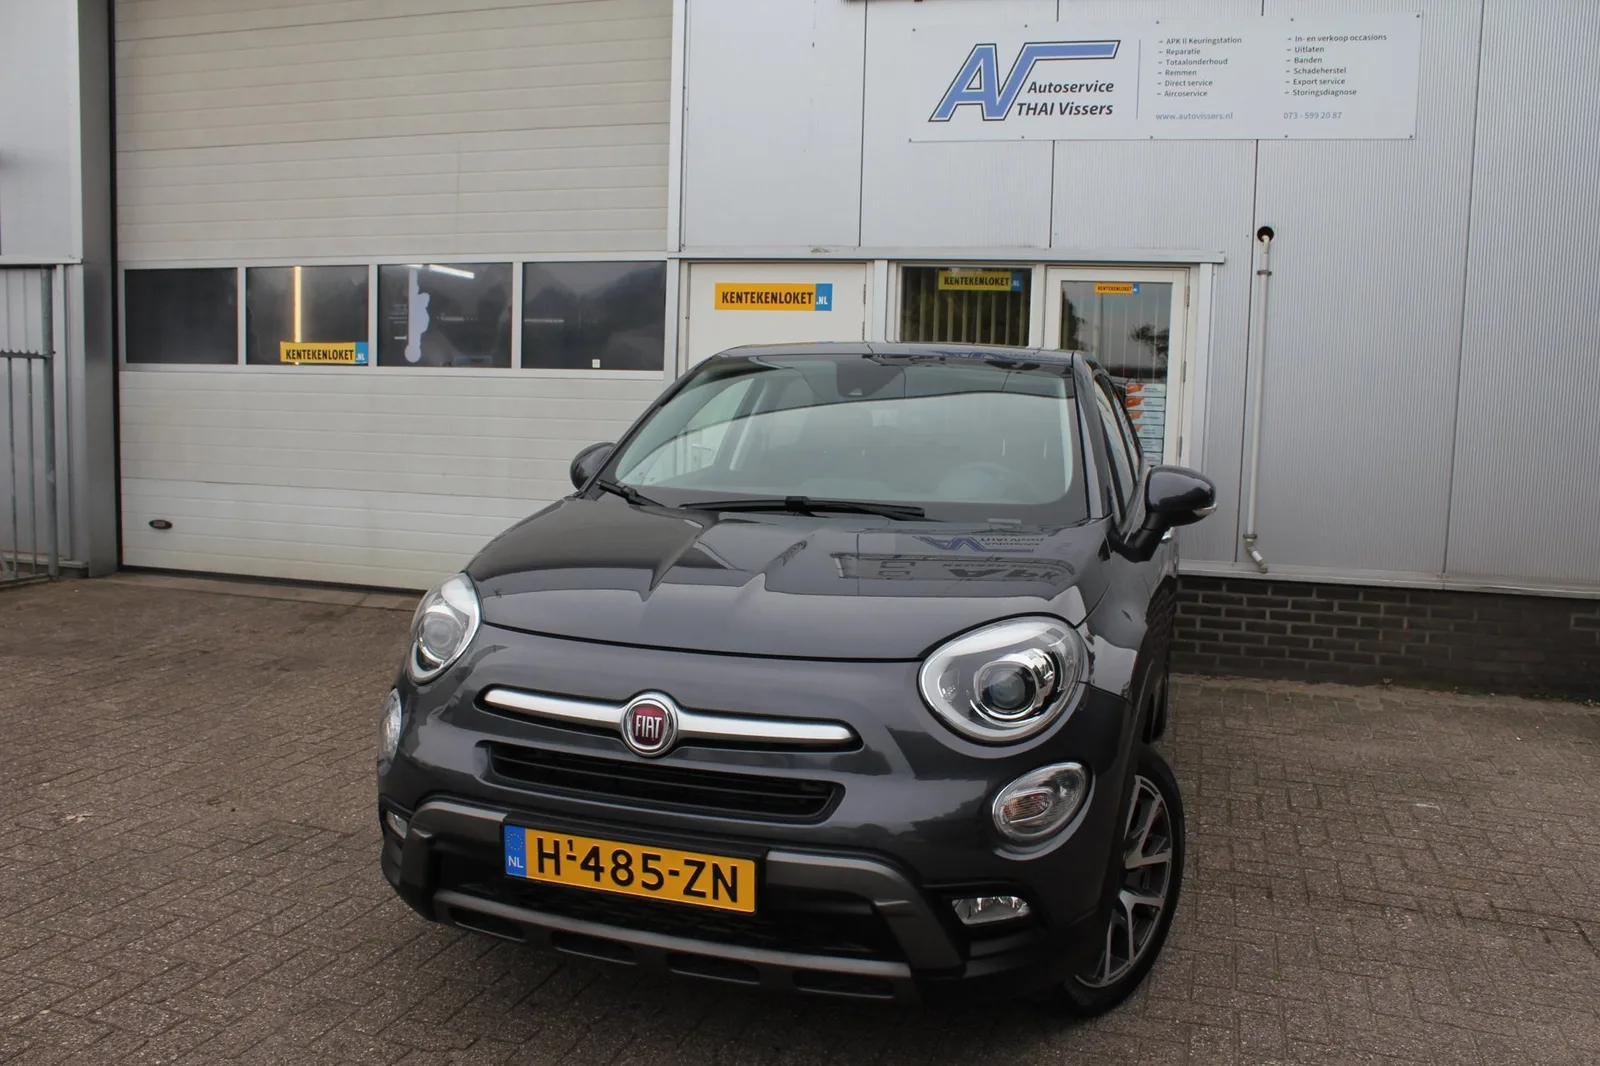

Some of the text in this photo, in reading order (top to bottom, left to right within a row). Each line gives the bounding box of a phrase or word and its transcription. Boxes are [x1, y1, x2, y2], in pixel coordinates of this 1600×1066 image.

[1188, 37, 1242, 45] Keuringstation
[1317, 35, 1348, 43] verkoop
[1166, 48, 1201, 56] Reparatie
[1166, 58, 1228, 66] Totaalonderhoud
[1293, 78, 1318, 86] Export
[1027, 80, 1114, 94] Autoservice
[1292, 89, 1357, 97] Storingsdiagnose
[1016, 101, 1114, 117] THAI Vissers
[1155, 112, 1234, 120] www.autovissers.nl
[635, 714, 663, 739] FIAT
[508, 855, 524, 869] NL
